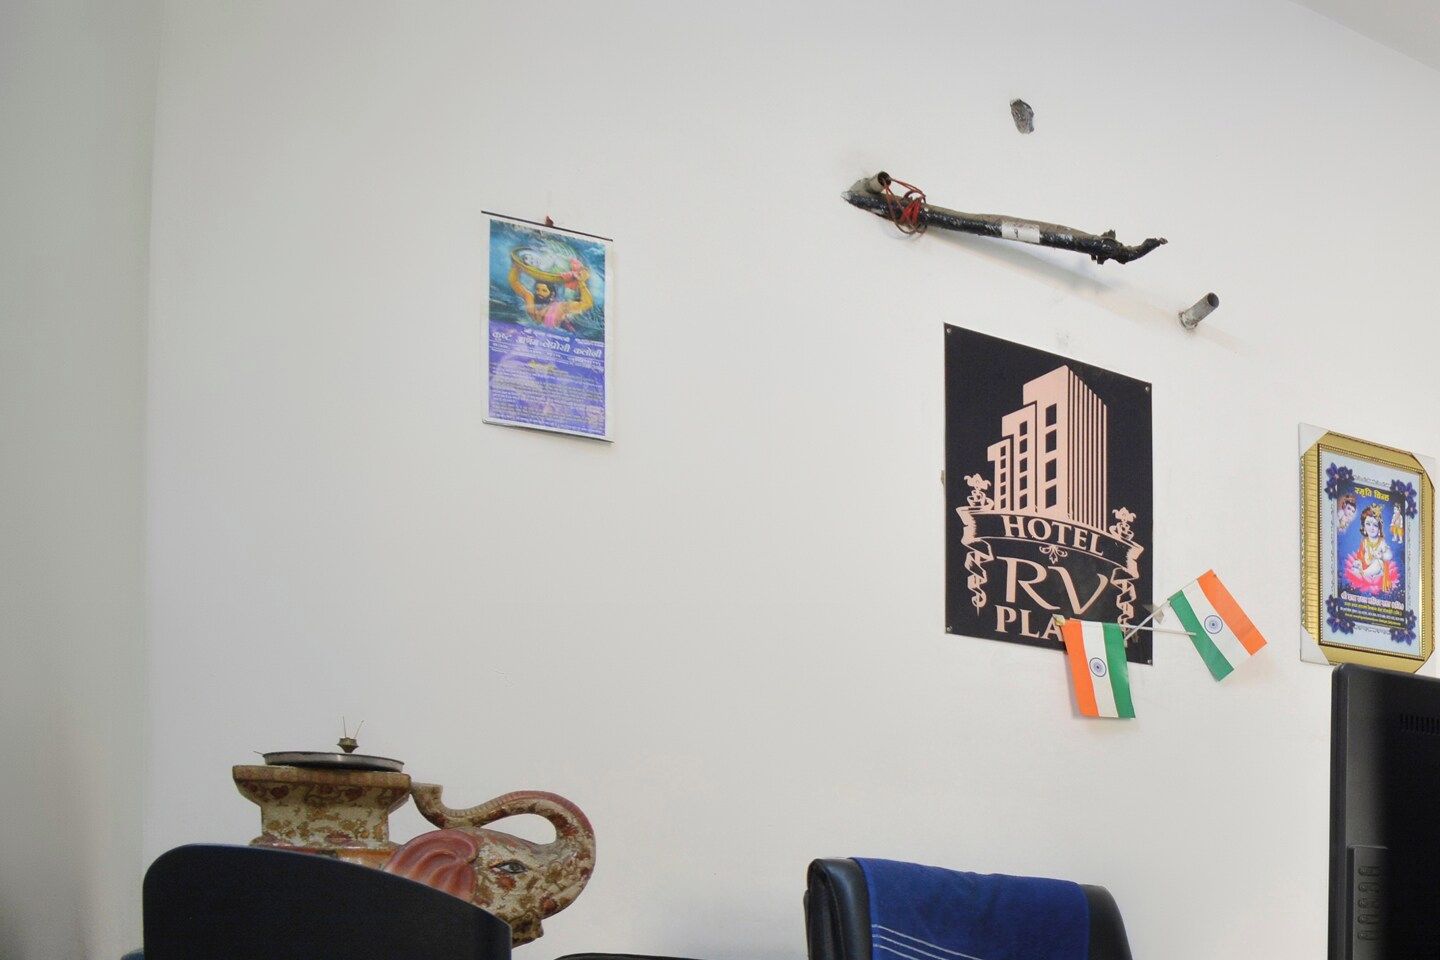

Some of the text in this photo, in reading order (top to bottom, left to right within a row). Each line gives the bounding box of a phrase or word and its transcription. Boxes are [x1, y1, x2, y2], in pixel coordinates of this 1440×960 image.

[1000, 514, 1104, 557] HOTEL
[996, 555, 1109, 615] RV
[995, 604, 1064, 642] PLA
